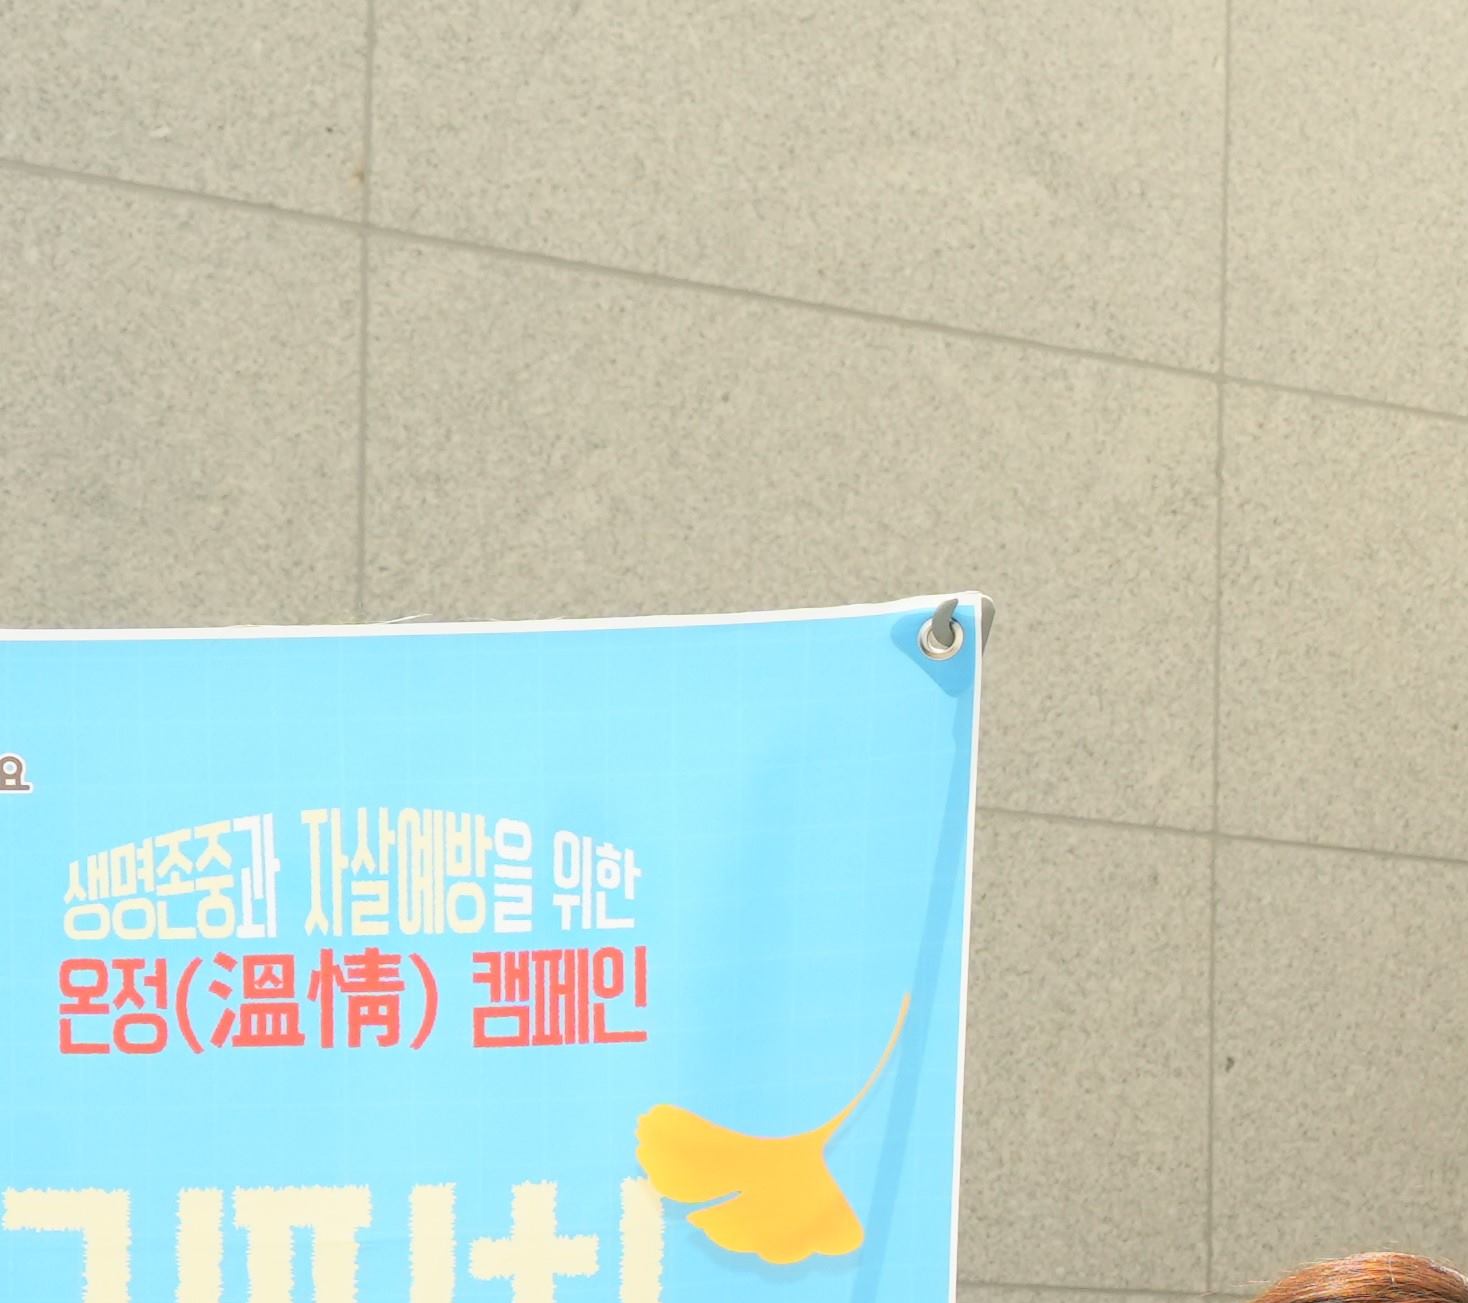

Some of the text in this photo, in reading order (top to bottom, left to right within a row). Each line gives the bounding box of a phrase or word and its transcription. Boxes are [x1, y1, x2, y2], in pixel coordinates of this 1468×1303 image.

[62, 806, 643, 941] 생명존중과 자살예방을 위한
[57, 944, 650, 1056] 온정(溫情) 캠페인
